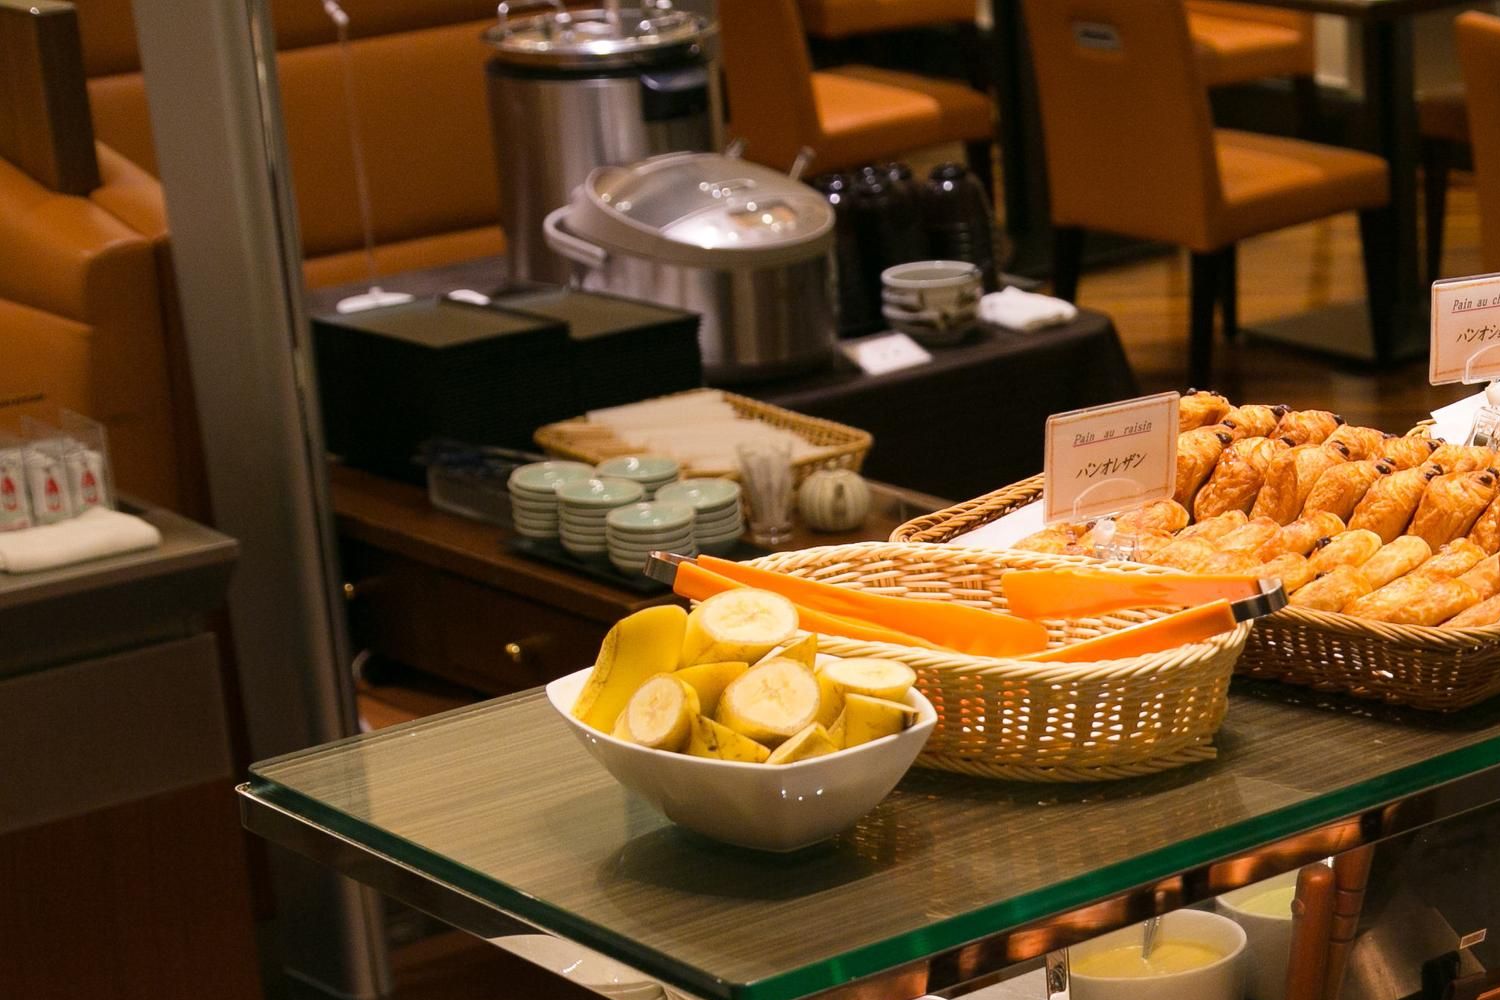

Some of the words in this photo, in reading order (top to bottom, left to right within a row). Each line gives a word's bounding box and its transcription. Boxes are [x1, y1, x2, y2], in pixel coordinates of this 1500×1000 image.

[1452, 298, 1473, 312] Pain
[1477, 297, 1488, 308] au
[1073, 431, 1096, 445] Pain
[1103, 428, 1116, 439] au
[1123, 420, 1153, 435] raisin
